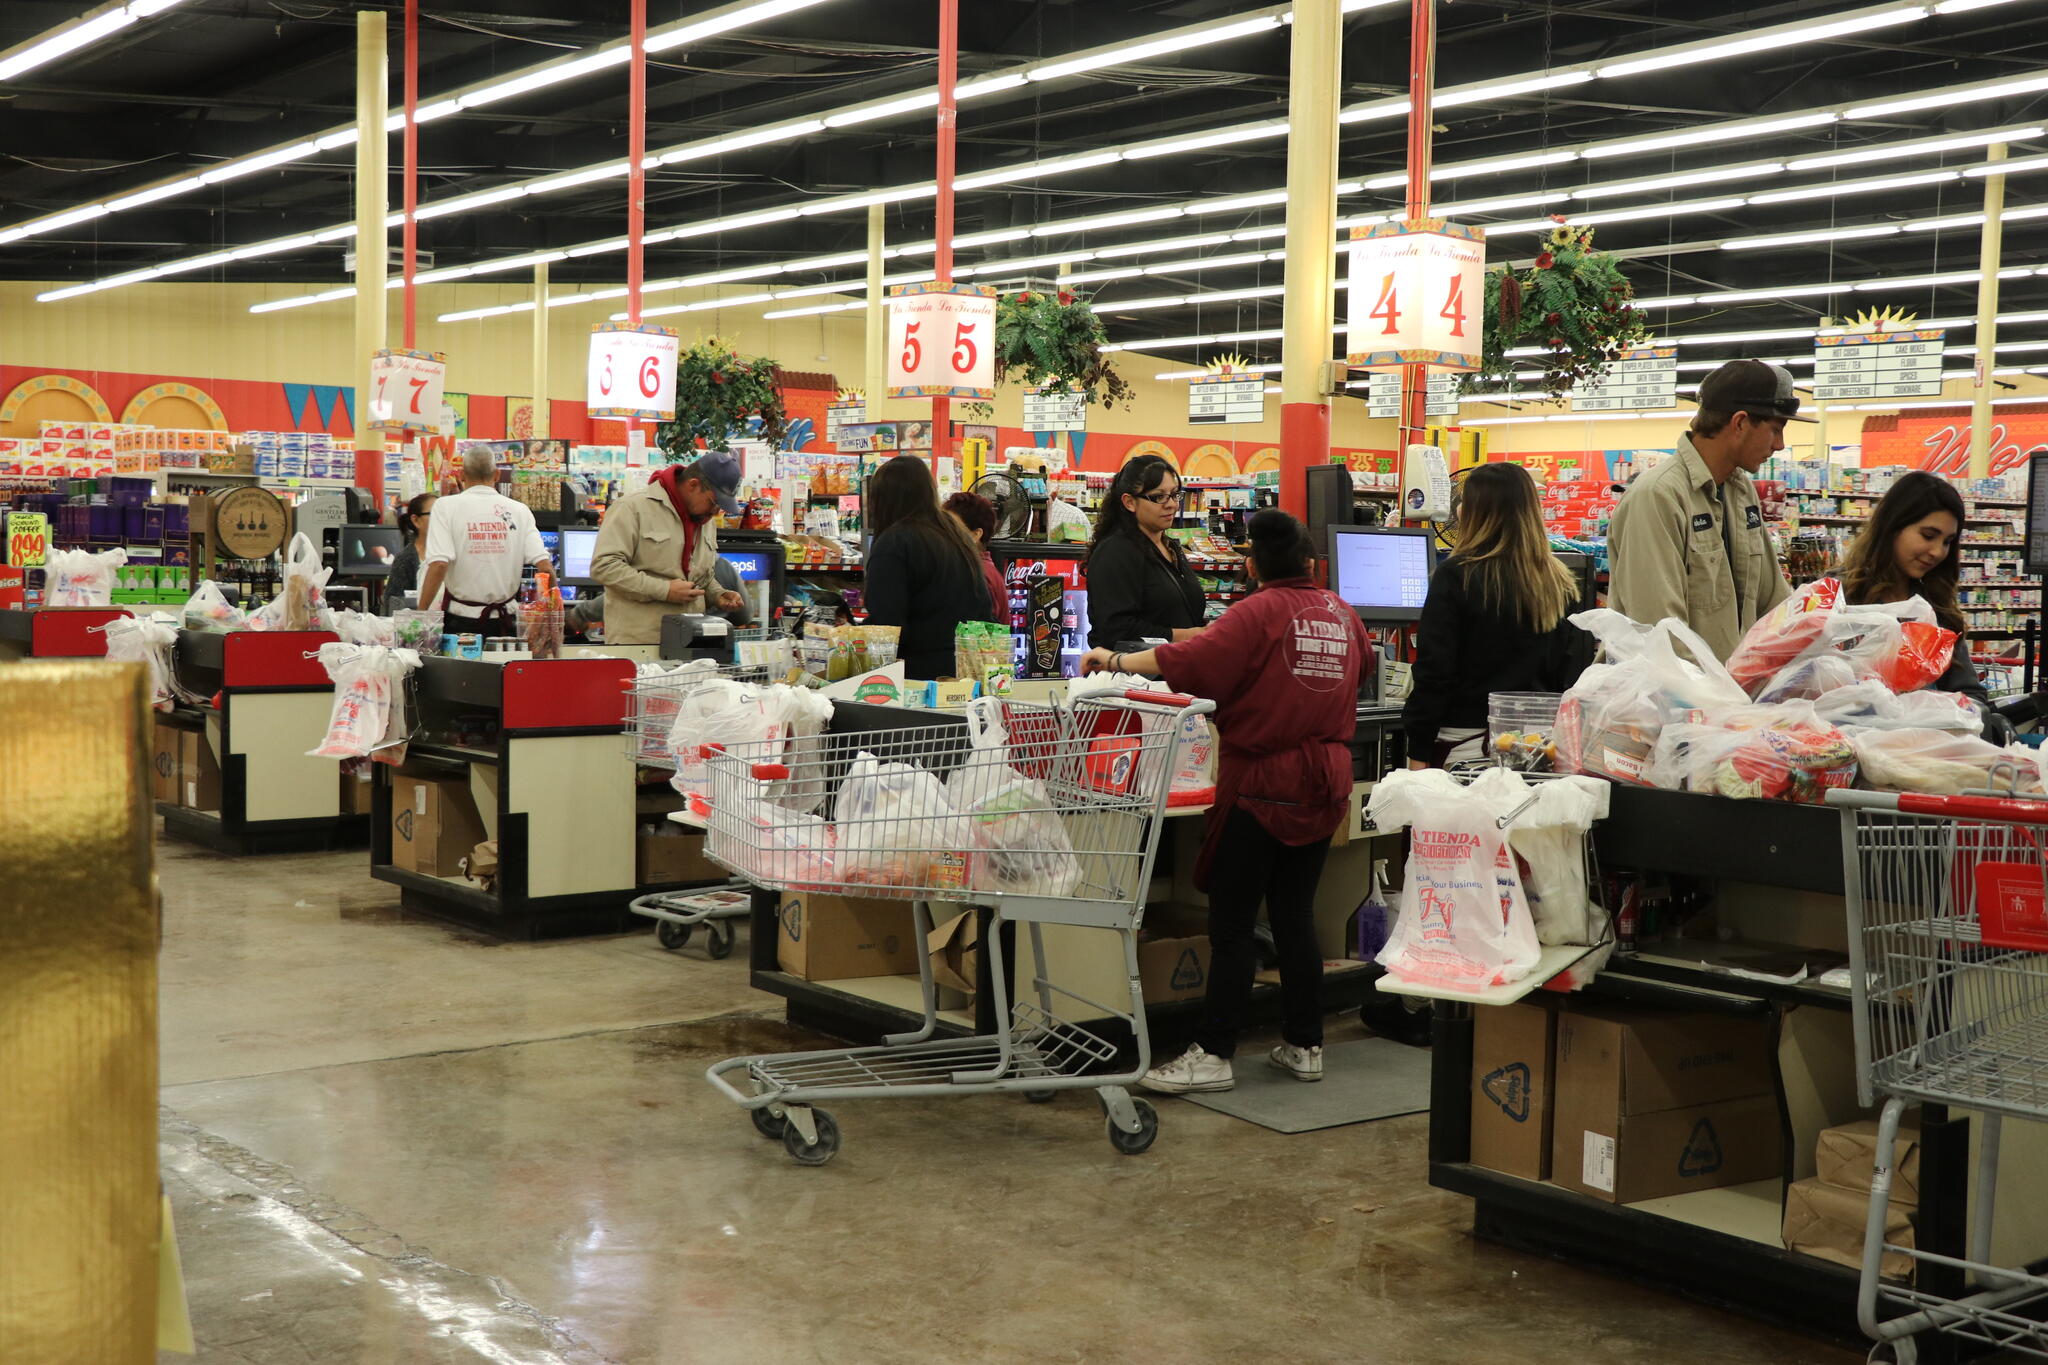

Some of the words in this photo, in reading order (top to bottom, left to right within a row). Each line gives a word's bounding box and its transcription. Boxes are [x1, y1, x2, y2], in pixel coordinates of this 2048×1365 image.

[1444, 245, 1481, 263] Tienda
[1369, 271, 1402, 335] 4
[1440, 273, 1466, 337] 4
[901, 321, 921, 374] 5
[952, 322, 977, 374] 5
[1829, 361, 1846, 370] COFFEE
[1852, 361, 1861, 369] TEA
[1901, 358, 1917, 367] FLOUR
[639, 356, 660, 398] 6
[1900, 372, 1917, 380] SPICES
[409, 377, 429, 414] 7
[855, 438, 869, 448] FUN
[467, 522, 478, 532] LA
[479, 522, 507, 532] TIENDA
[468, 532, 507, 541] THRIFTWAY
[731, 559, 757, 573] epsi
[1293, 619, 1312, 637] LA
[1310, 620, 1348, 641] TIENDA
[1616, 757, 1638, 772] Bacon
[1422, 831, 1481, 847] TIENDA
